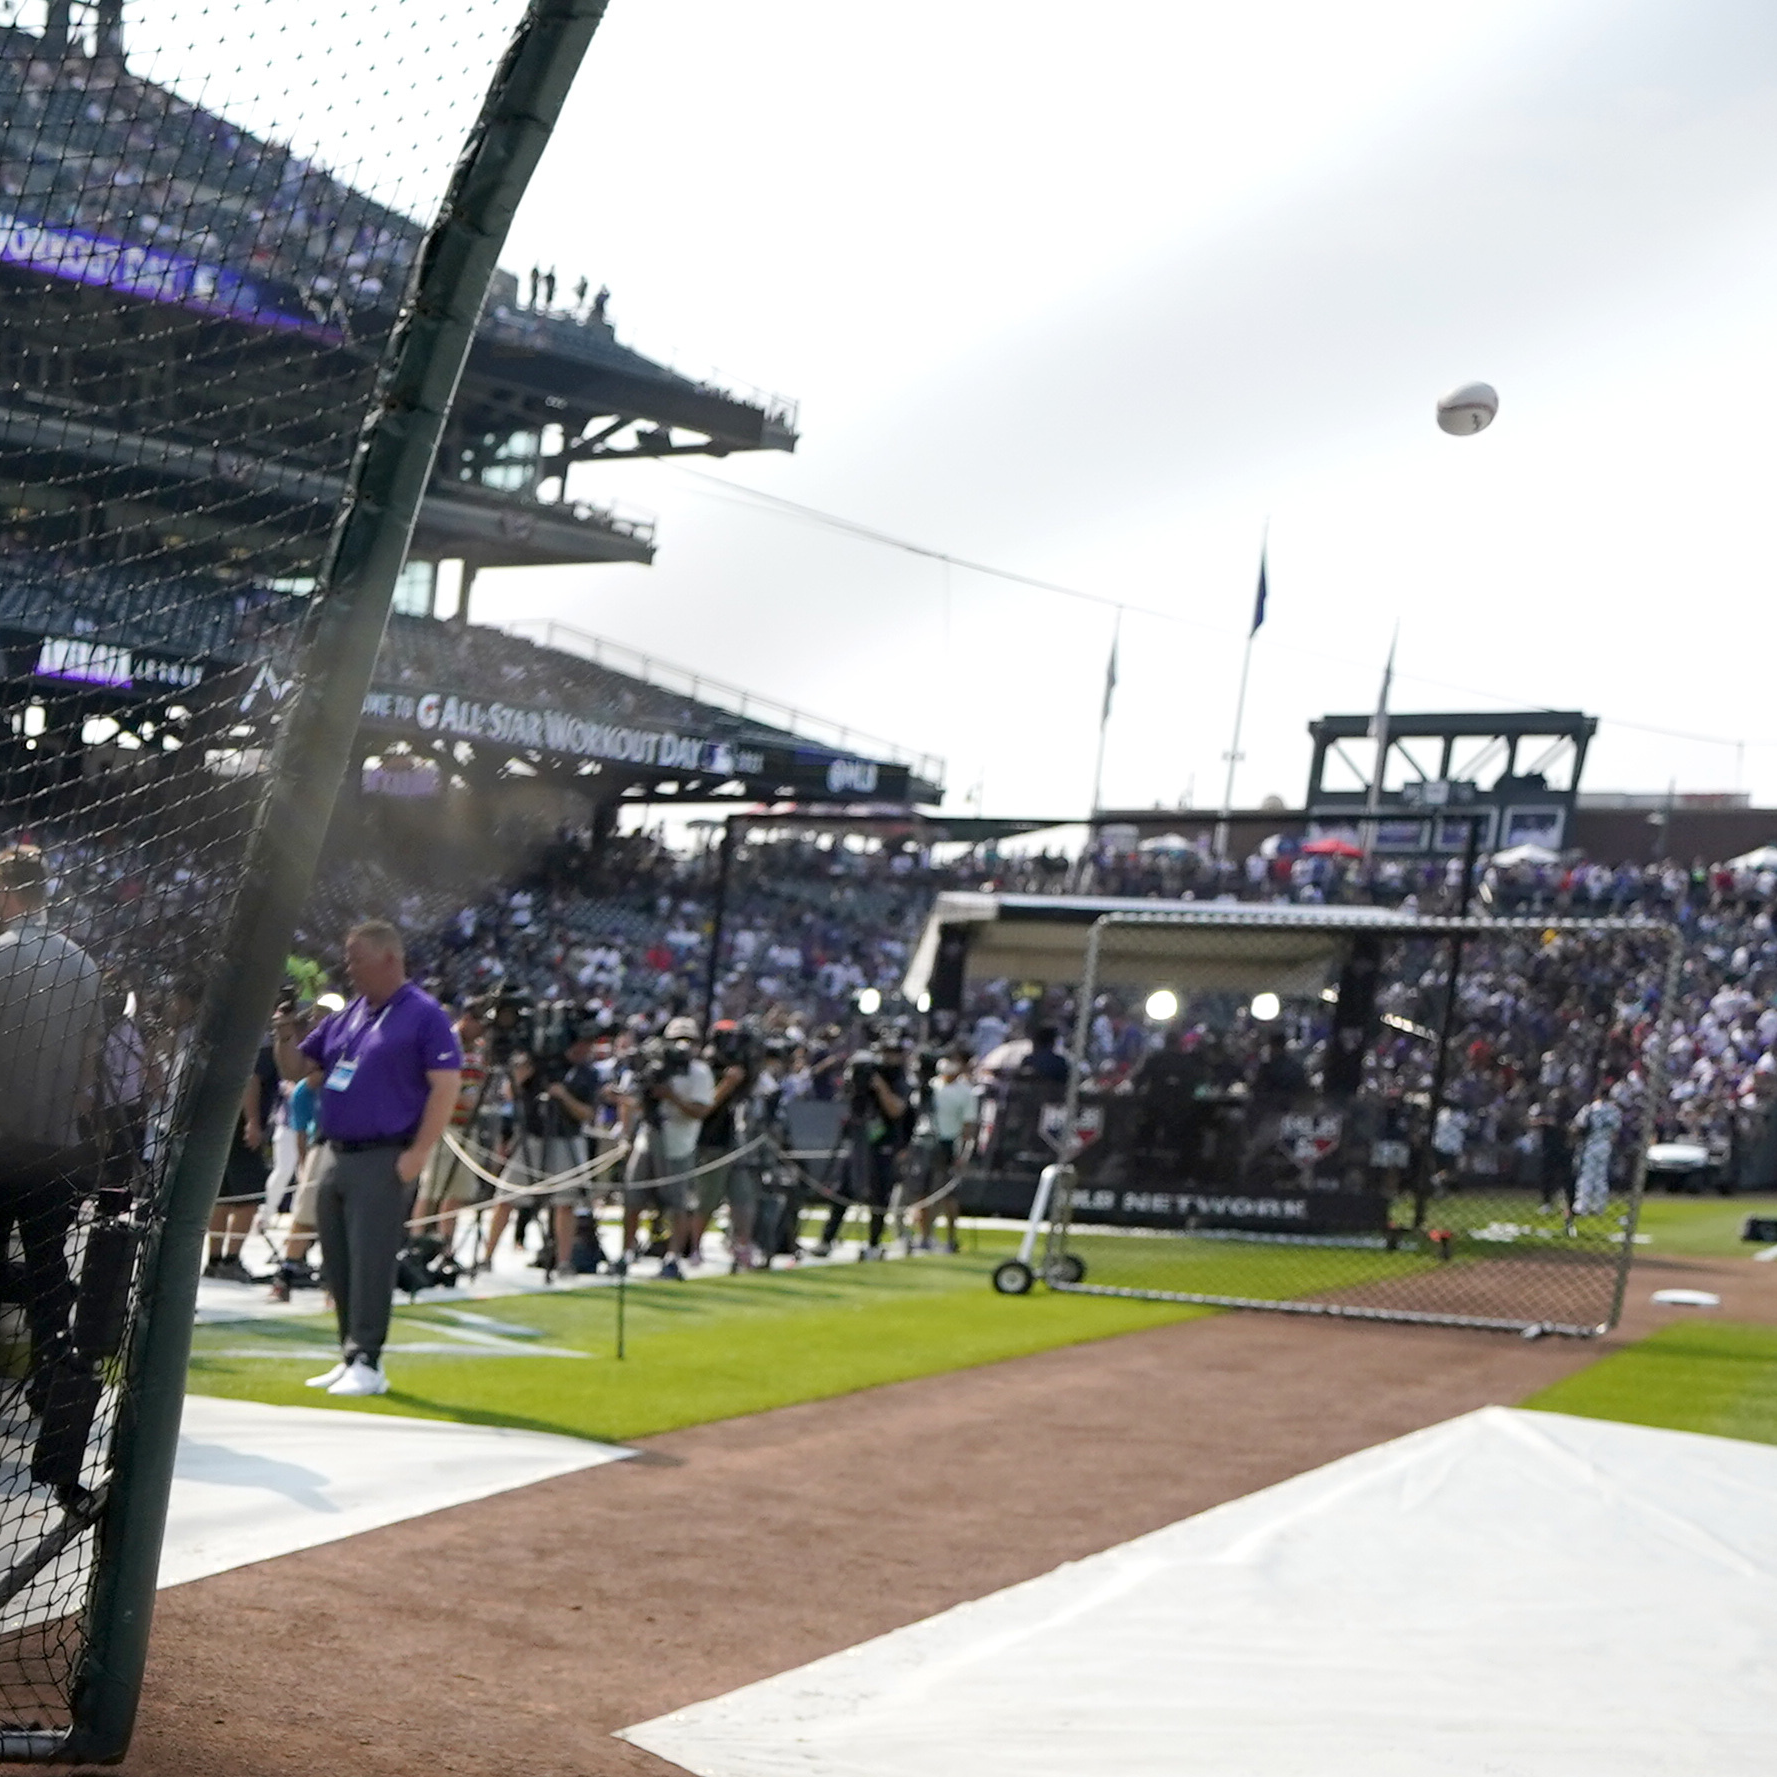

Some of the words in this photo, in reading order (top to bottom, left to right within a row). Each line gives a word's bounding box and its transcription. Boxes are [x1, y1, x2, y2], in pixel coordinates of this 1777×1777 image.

[544, 709, 659, 764] WORKOUT
[658, 731, 703, 771] DAY
[1122, 1190, 1307, 1217] NETWORK
